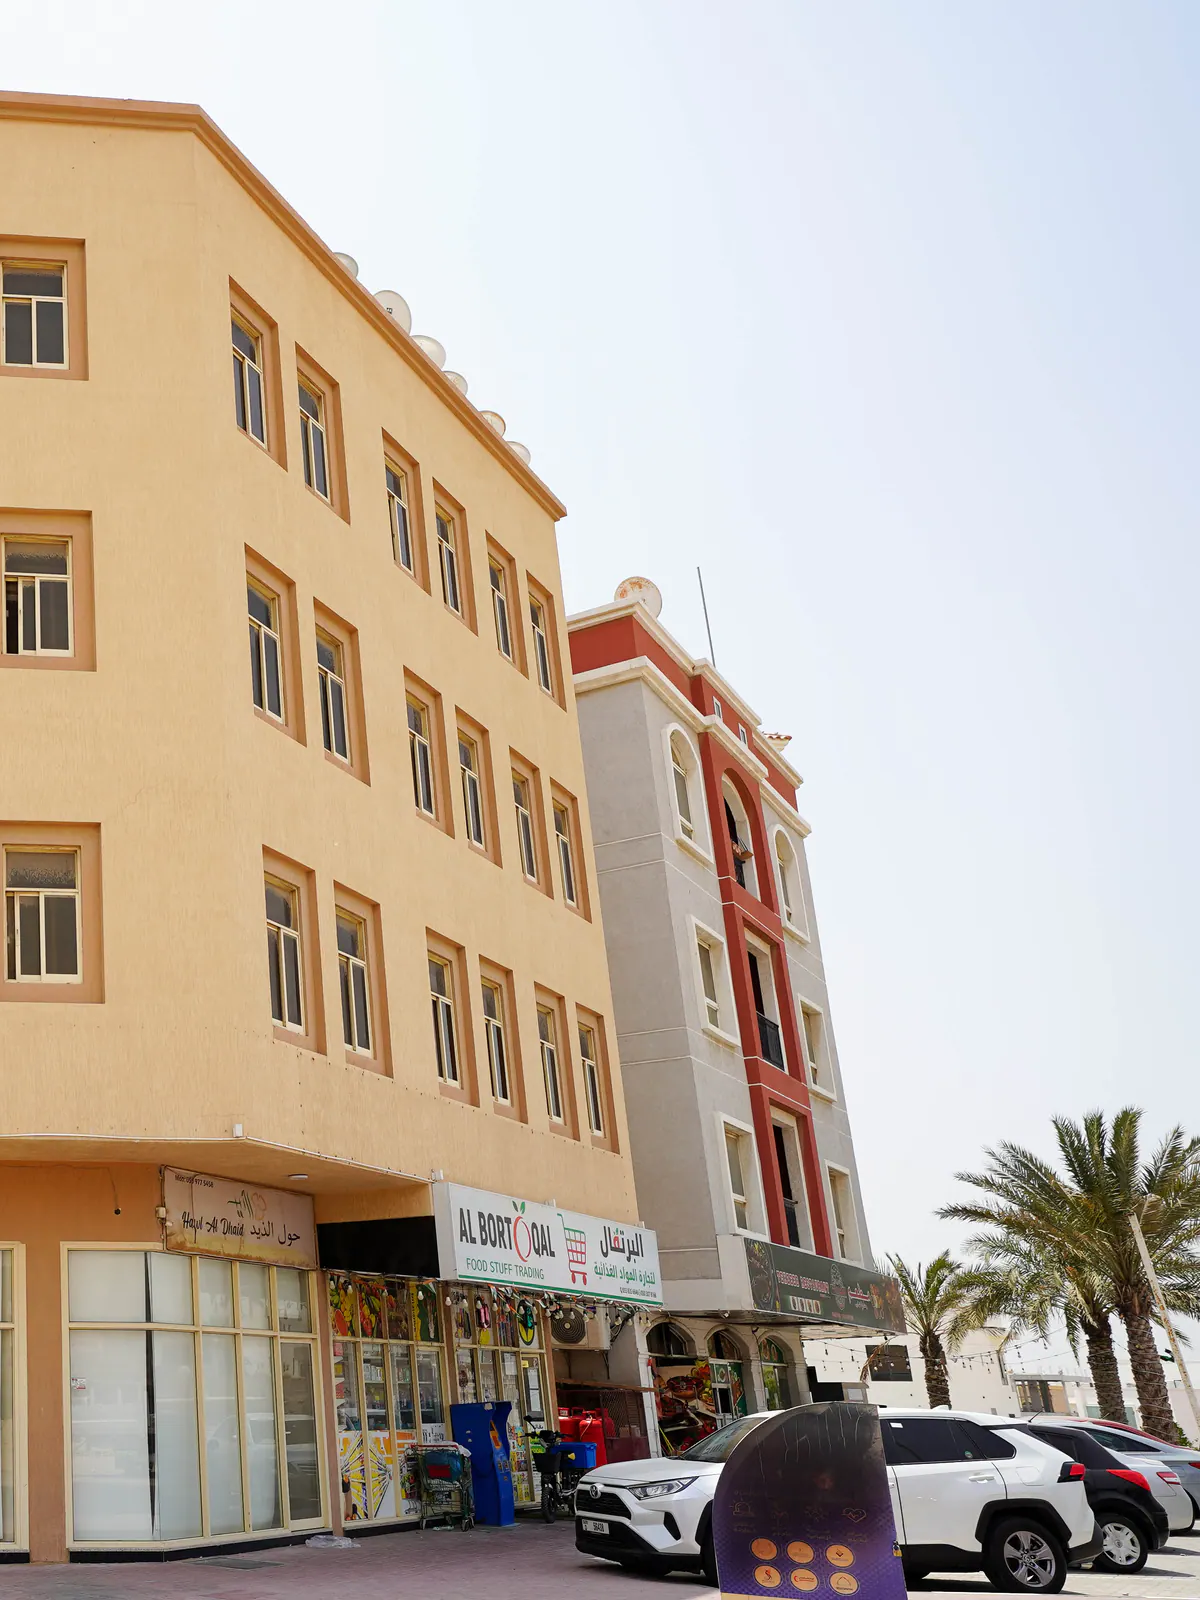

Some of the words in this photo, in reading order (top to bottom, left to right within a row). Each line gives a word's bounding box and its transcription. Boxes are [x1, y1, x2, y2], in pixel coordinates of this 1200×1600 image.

[205, 1216, 218, 1234] Al
[220, 1217, 245, 1237] Dhaid
[250, 1220, 274, 1240] الذيد
[277, 1223, 301, 1247] حول
[460, 1207, 477, 1245] AL
[478, 1211, 556, 1262] BORTOQAL
[600, 1225, 644, 1264] البرتقال
[466, 1257, 488, 1272] FOOD
[490, 1261, 513, 1275] STUFF
[514, 1264, 545, 1280] TRADING
